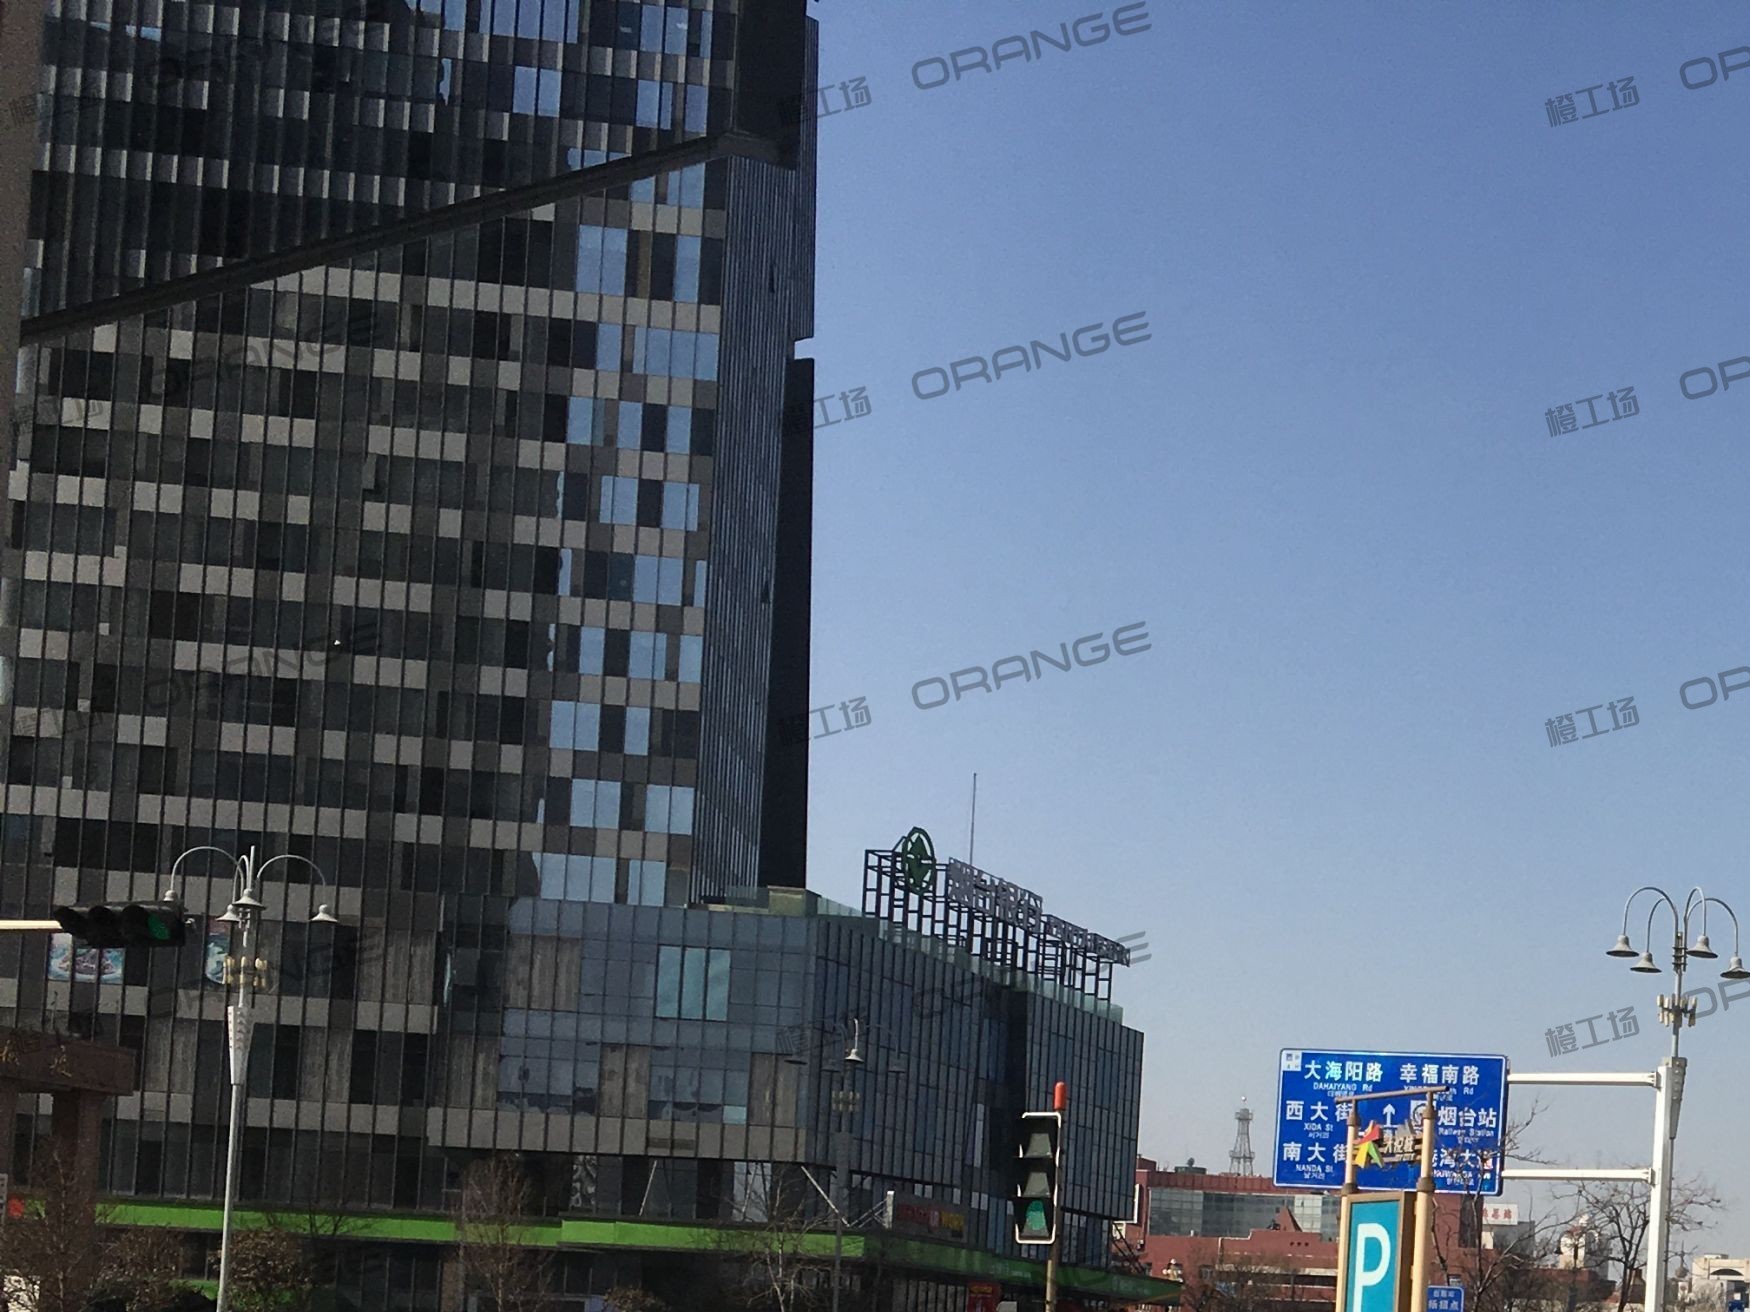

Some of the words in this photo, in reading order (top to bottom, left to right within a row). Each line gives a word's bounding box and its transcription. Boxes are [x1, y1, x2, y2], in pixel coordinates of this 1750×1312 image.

[1304, 1060, 1383, 1082] 大海阳路
[1400, 1063, 1479, 1085] 幸福南路
[1286, 1101, 1353, 1122] 西大街
[1437, 1106, 1497, 1128] 烟台站
[1283, 1141, 1347, 1163] 南大街
